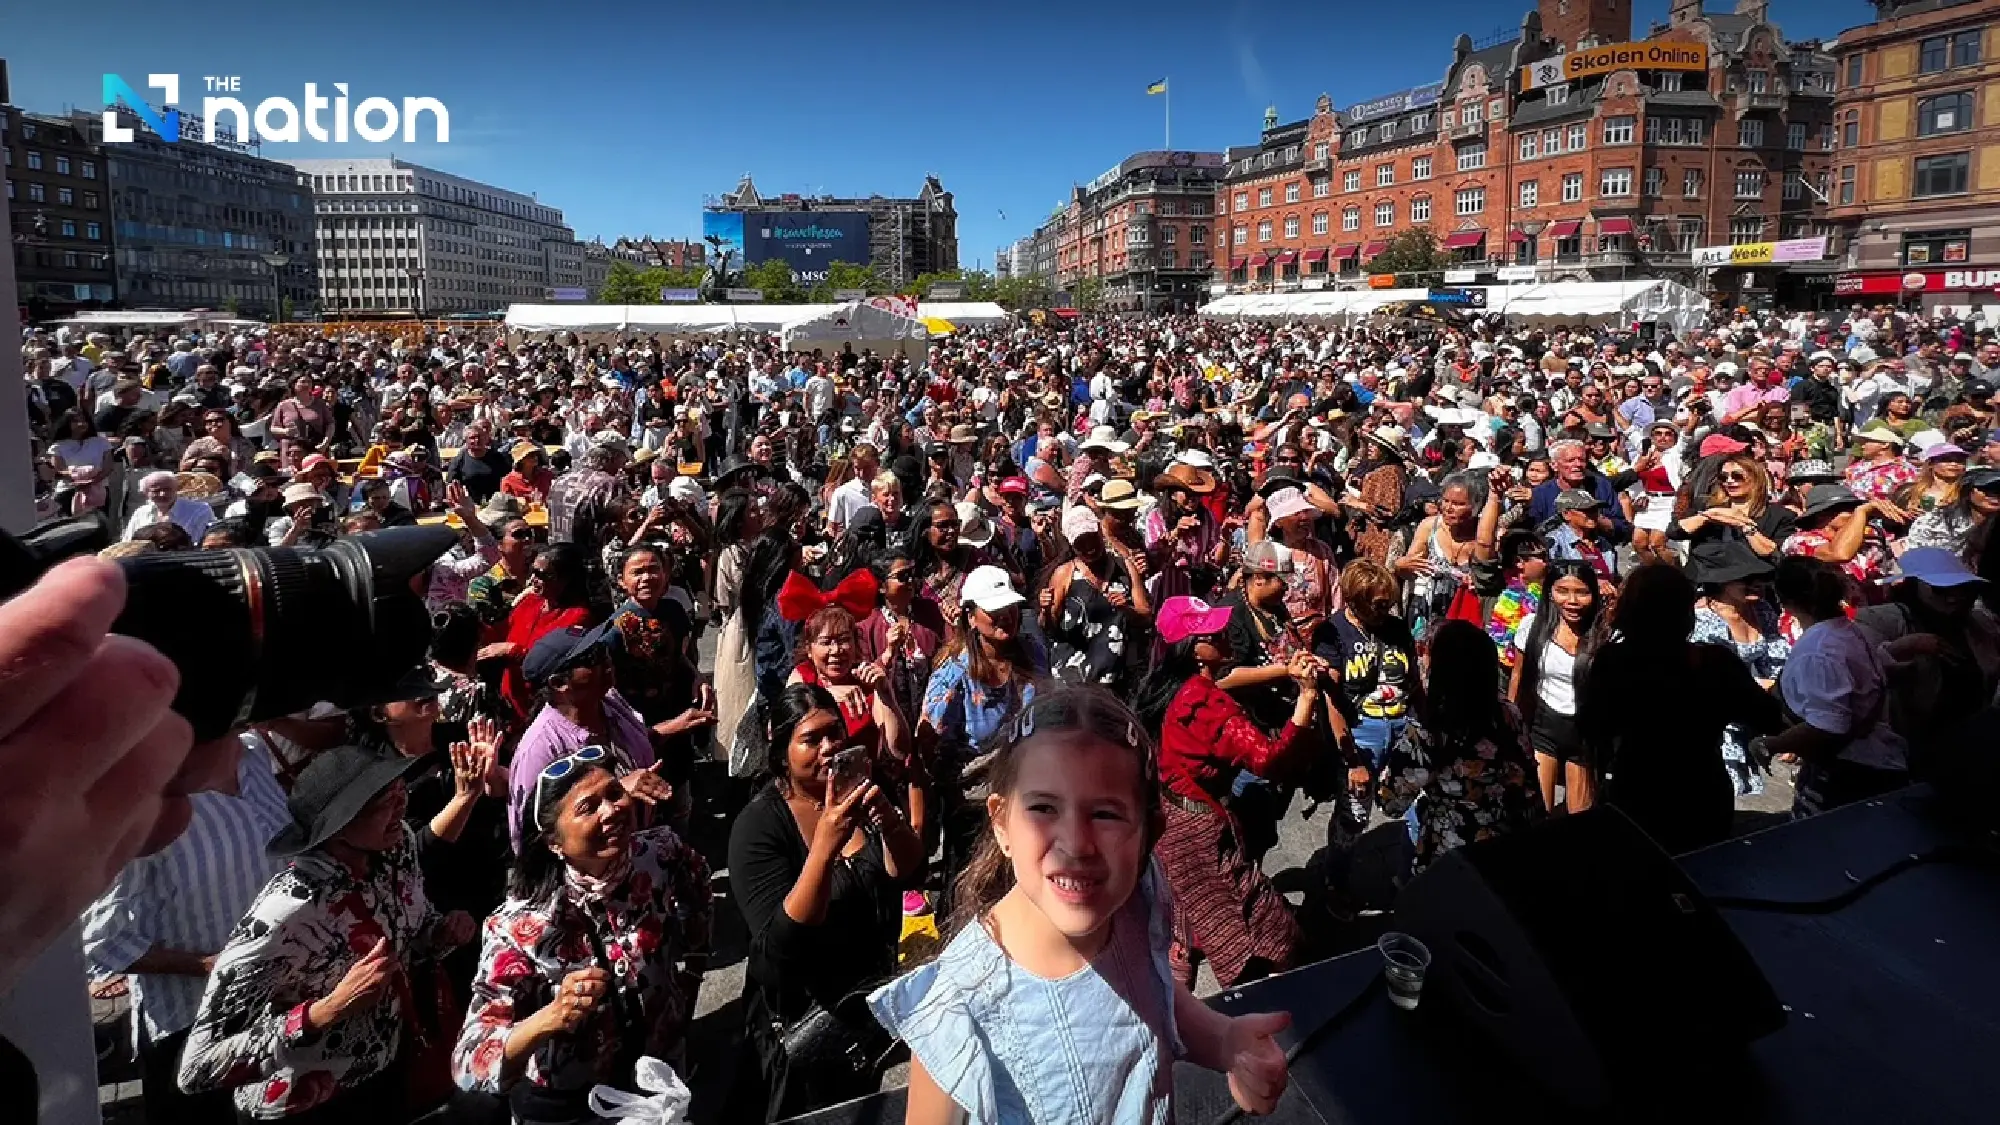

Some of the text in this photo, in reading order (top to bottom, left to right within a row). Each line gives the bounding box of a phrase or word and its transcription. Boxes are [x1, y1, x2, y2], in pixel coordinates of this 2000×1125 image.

[1570, 46, 1700, 72] Skolen Online
[1701, 251, 1722, 263] Art
[1730, 246, 1769, 261] Week
[801, 271, 829, 281] MSC
